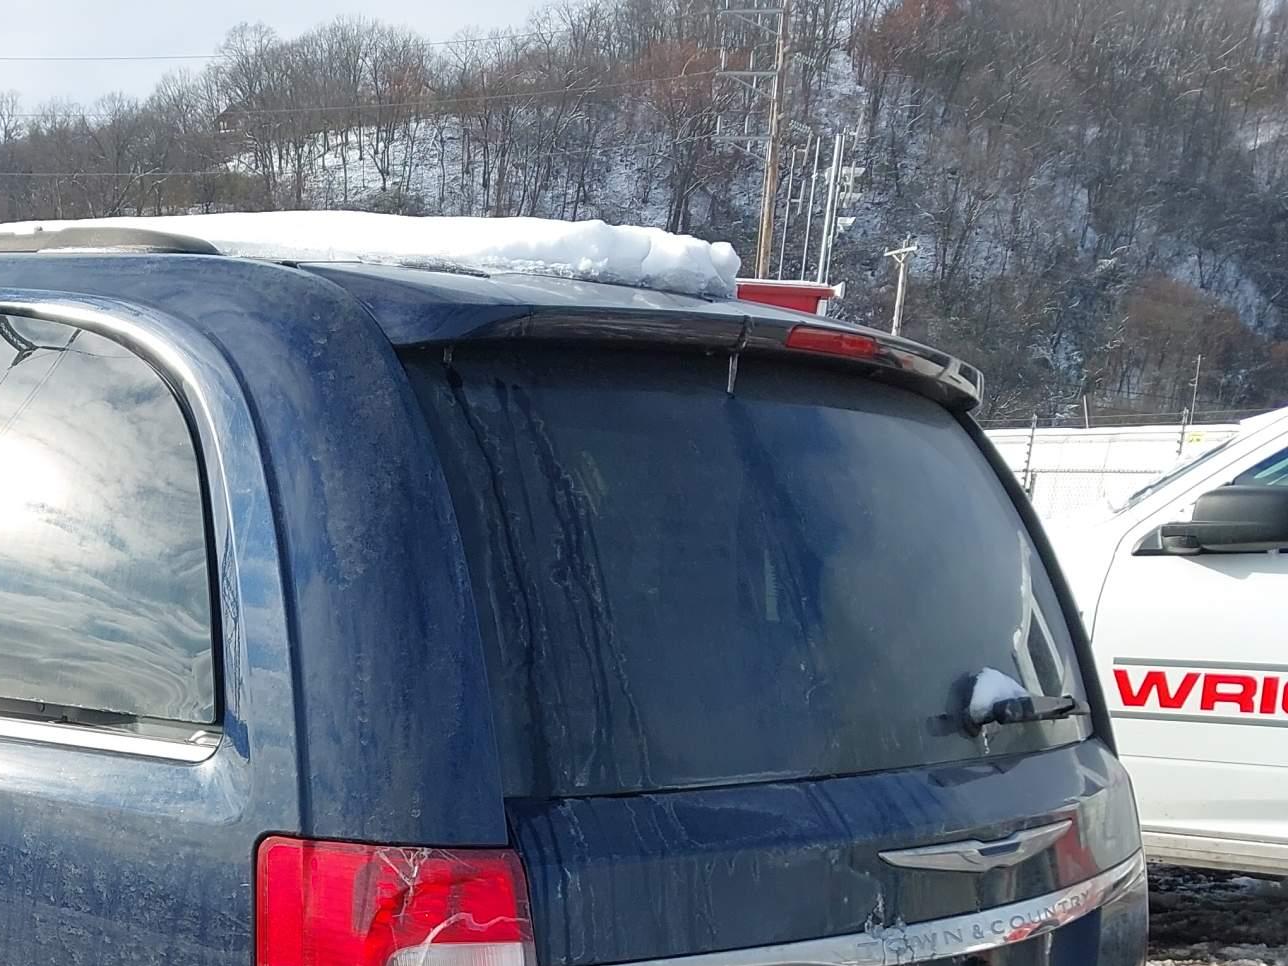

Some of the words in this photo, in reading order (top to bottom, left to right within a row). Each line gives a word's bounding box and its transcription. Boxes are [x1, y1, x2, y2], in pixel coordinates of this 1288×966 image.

[1113, 668, 1288, 715] WRI
[857, 928, 962, 955] TWN
[990, 889, 1090, 935] COUNTRY
